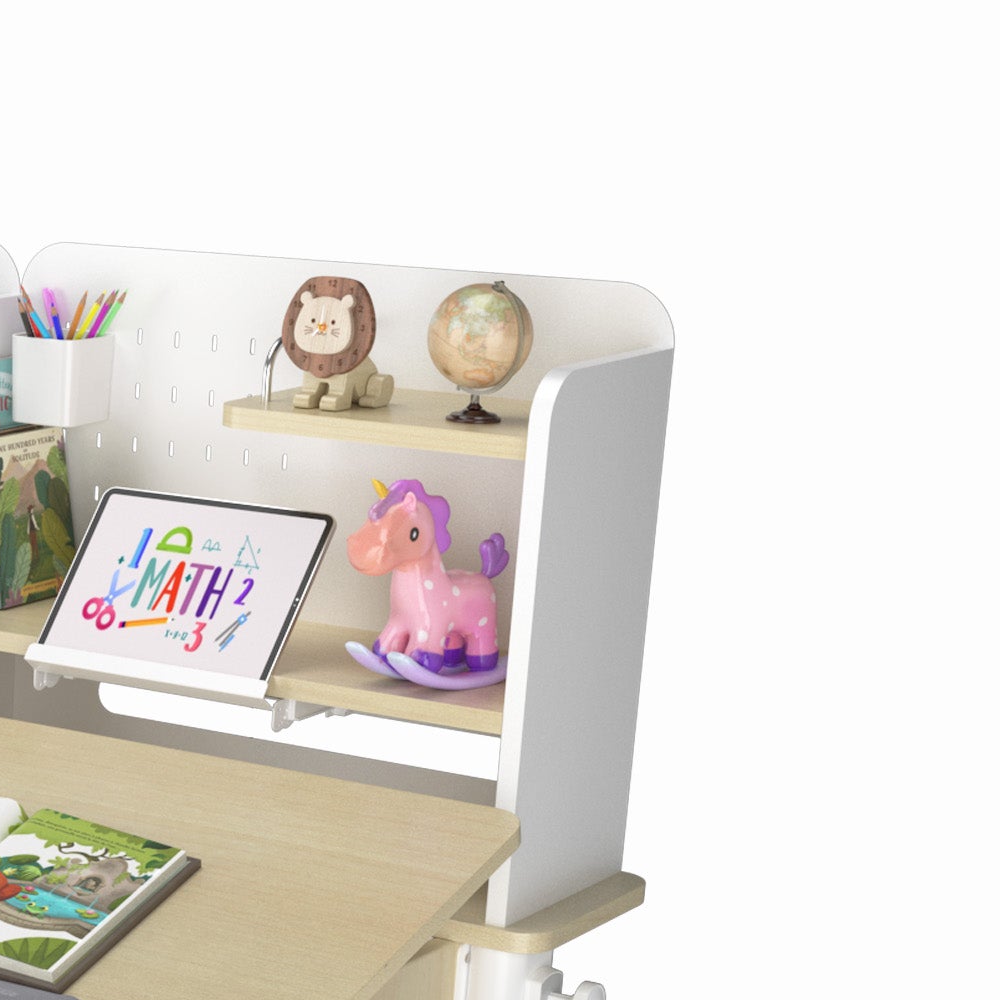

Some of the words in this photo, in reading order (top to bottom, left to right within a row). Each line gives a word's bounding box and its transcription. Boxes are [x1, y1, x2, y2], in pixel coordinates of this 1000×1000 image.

[7, 439, 37, 450] HUNDRED
[37, 435, 56, 444] YEARS
[130, 557, 234, 620] MATH
[233, 578, 254, 606] 2
[184, 621, 207, 652] 3
